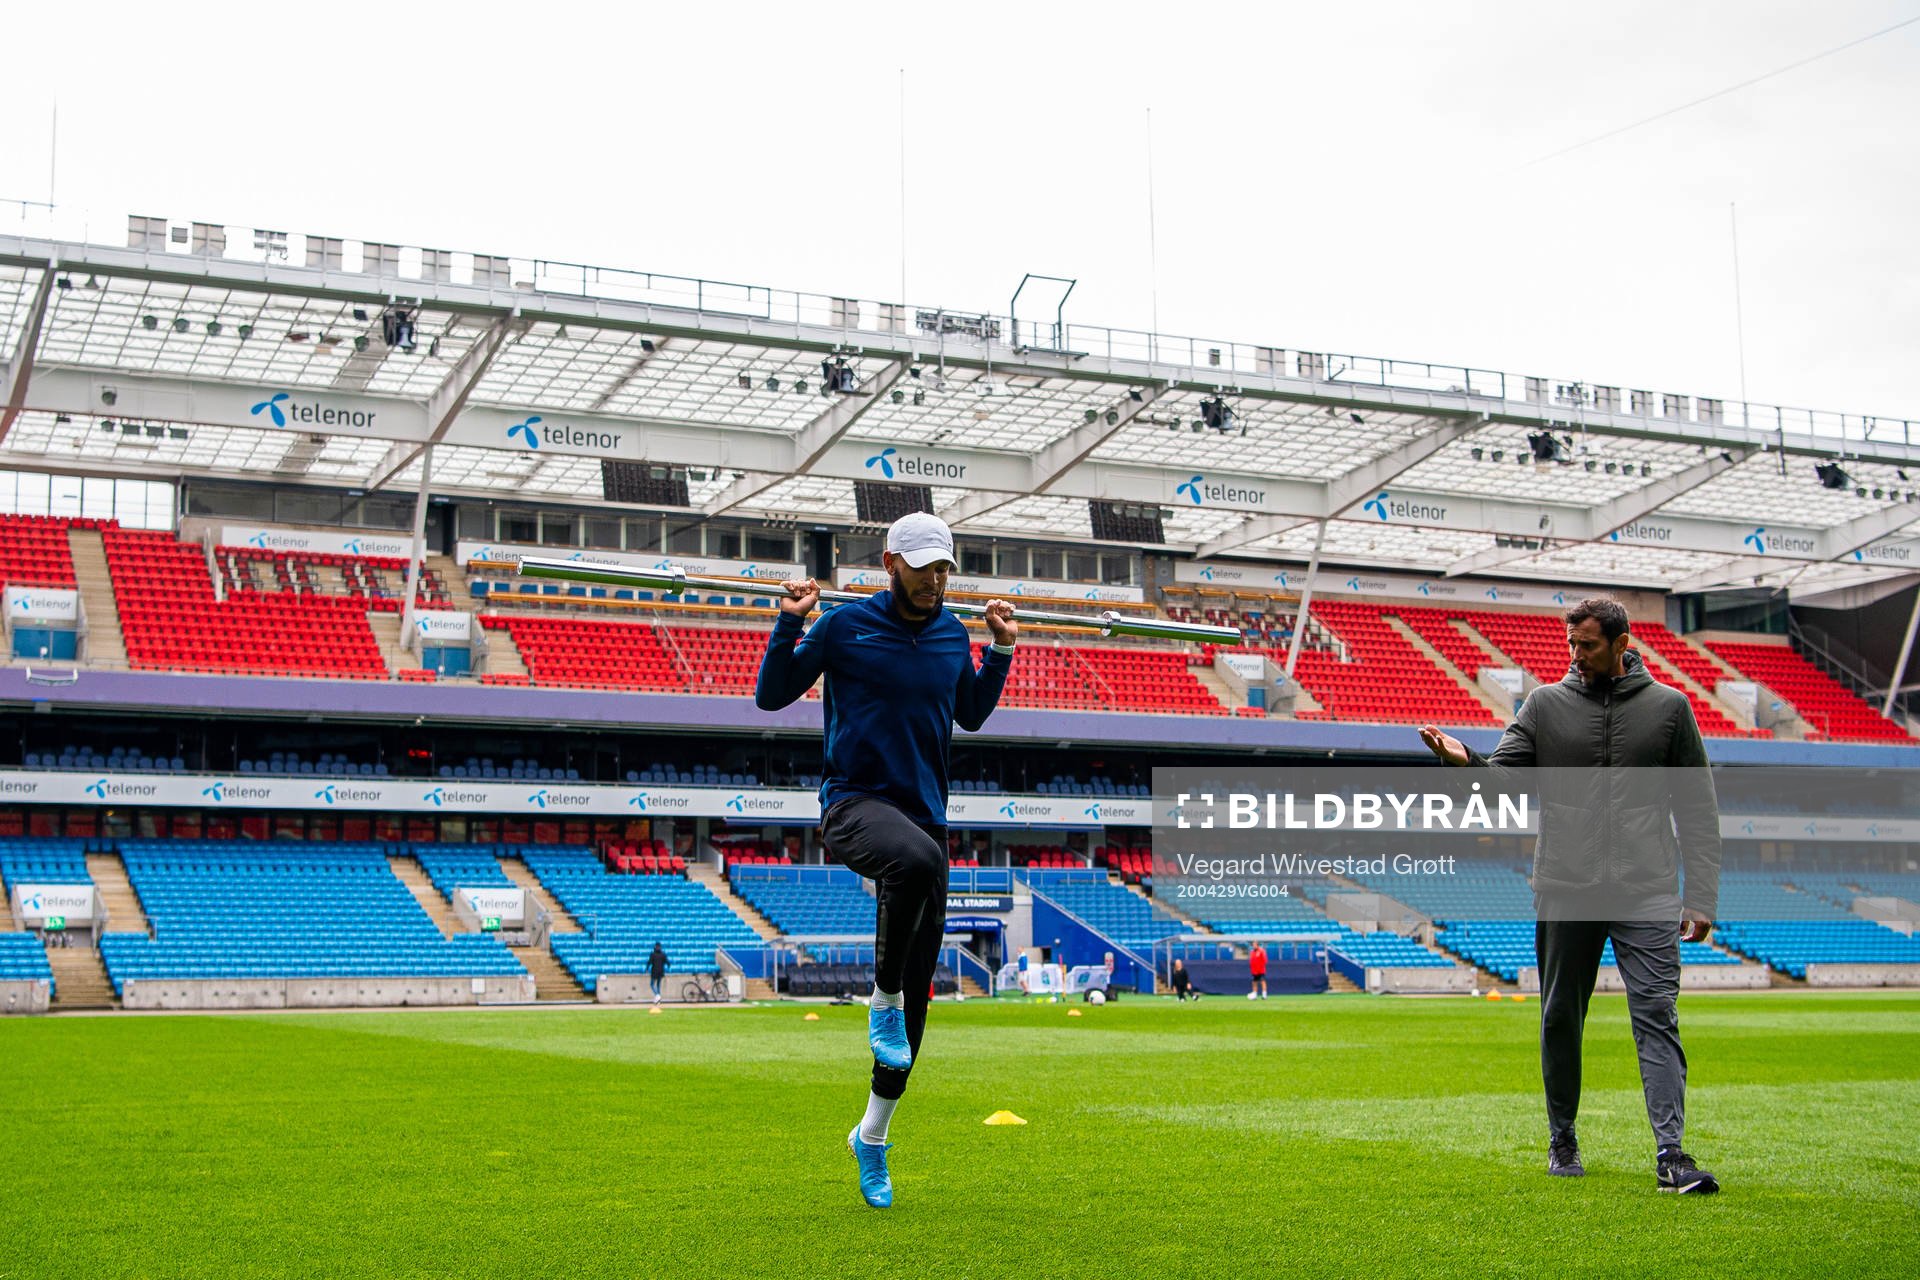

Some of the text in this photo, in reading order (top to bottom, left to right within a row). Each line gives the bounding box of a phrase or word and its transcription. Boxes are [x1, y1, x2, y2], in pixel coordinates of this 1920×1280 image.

[291, 402, 376, 428] telenor
[543, 426, 622, 449] telenor
[897, 456, 967, 479] telenor
[1204, 483, 1266, 504] telenor
[1389, 500, 1446, 520] telenor
[1619, 524, 1672, 541] telenor
[266, 535, 310, 549] telenor
[360, 541, 402, 554] telenor
[1766, 534, 1815, 553] telenor
[755, 569, 791, 579] telenor
[1212, 569, 1242, 580] telenor
[1023, 585, 1055, 597] telenor
[1358, 581, 1387, 592] telenor
[1098, 592, 1129, 603] telenor
[30, 598, 71, 611] telenor
[429, 618, 466, 632] telenor
[106, 782, 156, 798] telenor
[222, 787, 271, 801] telenor
[333, 790, 382, 803] telenor
[442, 791, 488, 805] telenor
[547, 794, 590, 807] telenor
[647, 797, 689, 810] telenor
[744, 797, 784, 811] telenor
[1014, 804, 1052, 818] telenor
[1099, 808, 1136, 819] telenor
[42, 897, 87, 909] telenor
[479, 898, 518, 911] telenor
[965, 899, 999, 907] STADION
